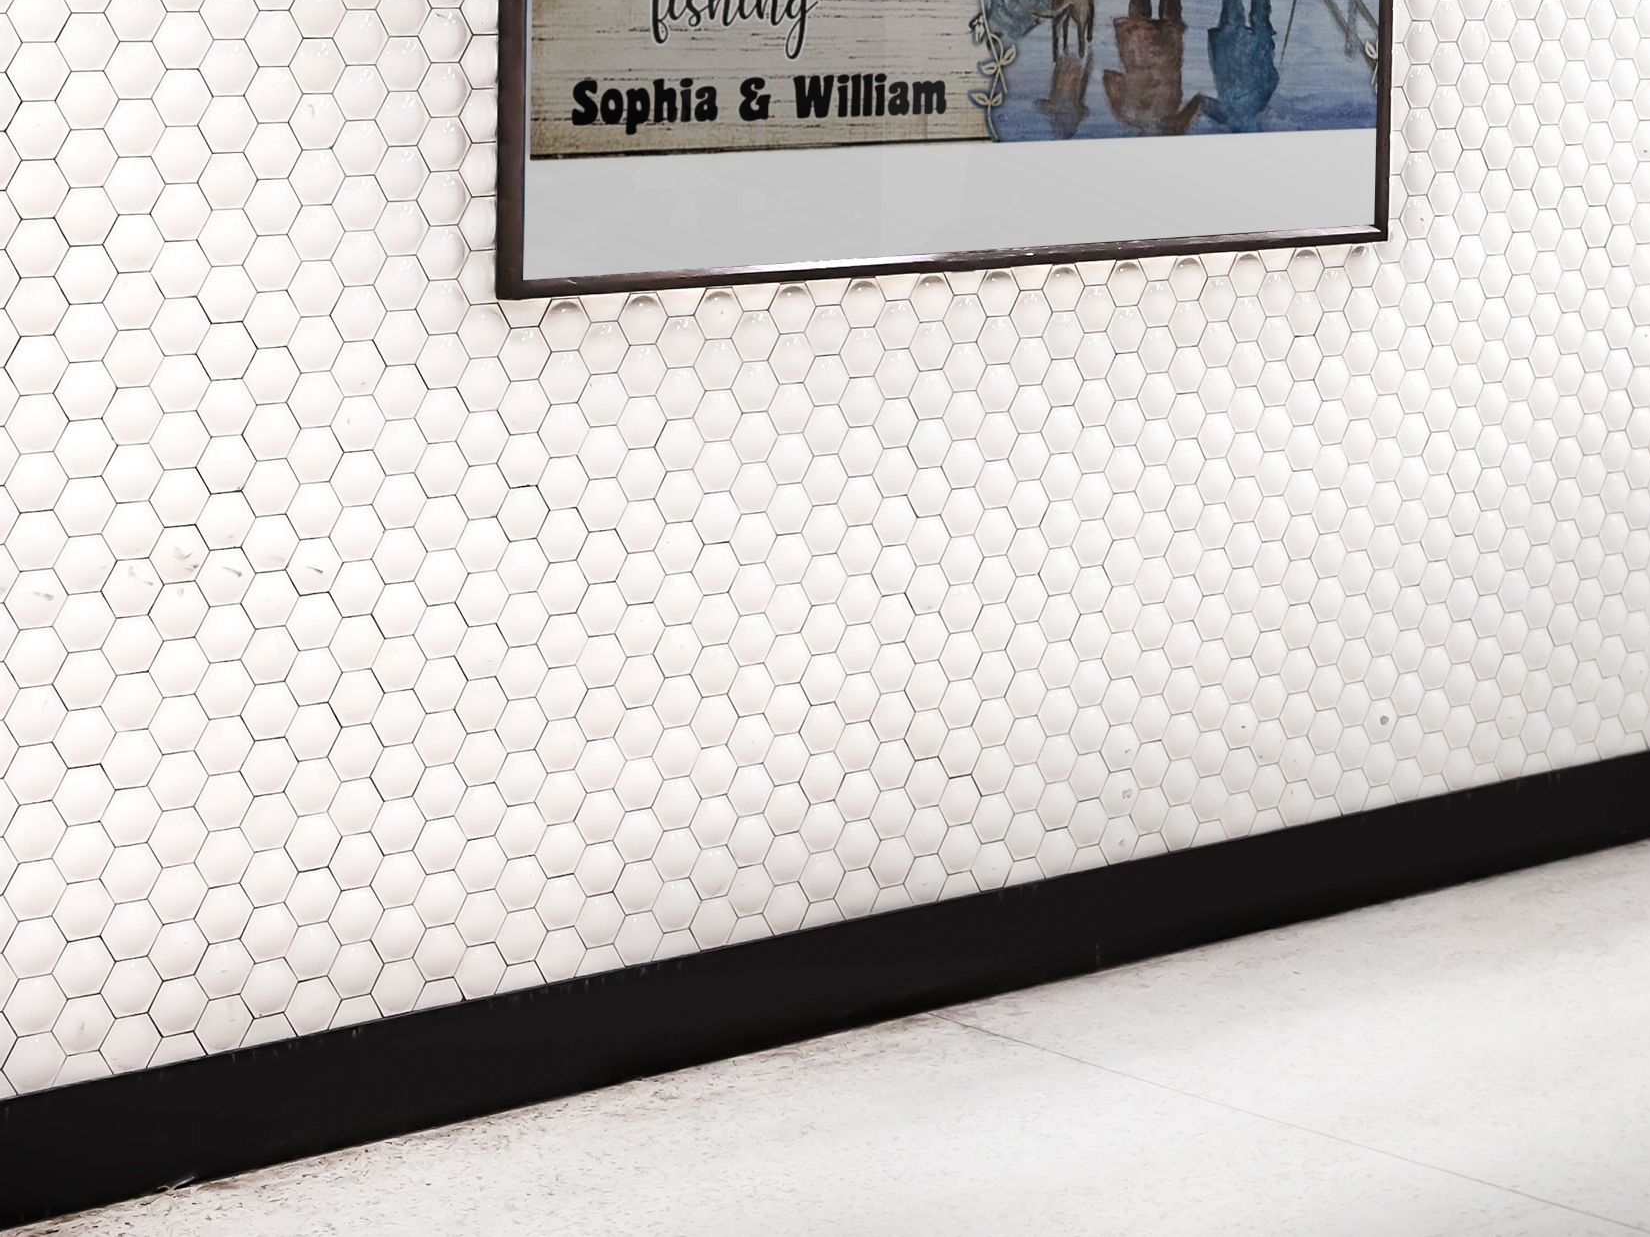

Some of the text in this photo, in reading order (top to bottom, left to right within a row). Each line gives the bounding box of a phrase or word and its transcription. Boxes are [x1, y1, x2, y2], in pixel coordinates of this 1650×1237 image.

[571, 73, 947, 135] Sophia & William
